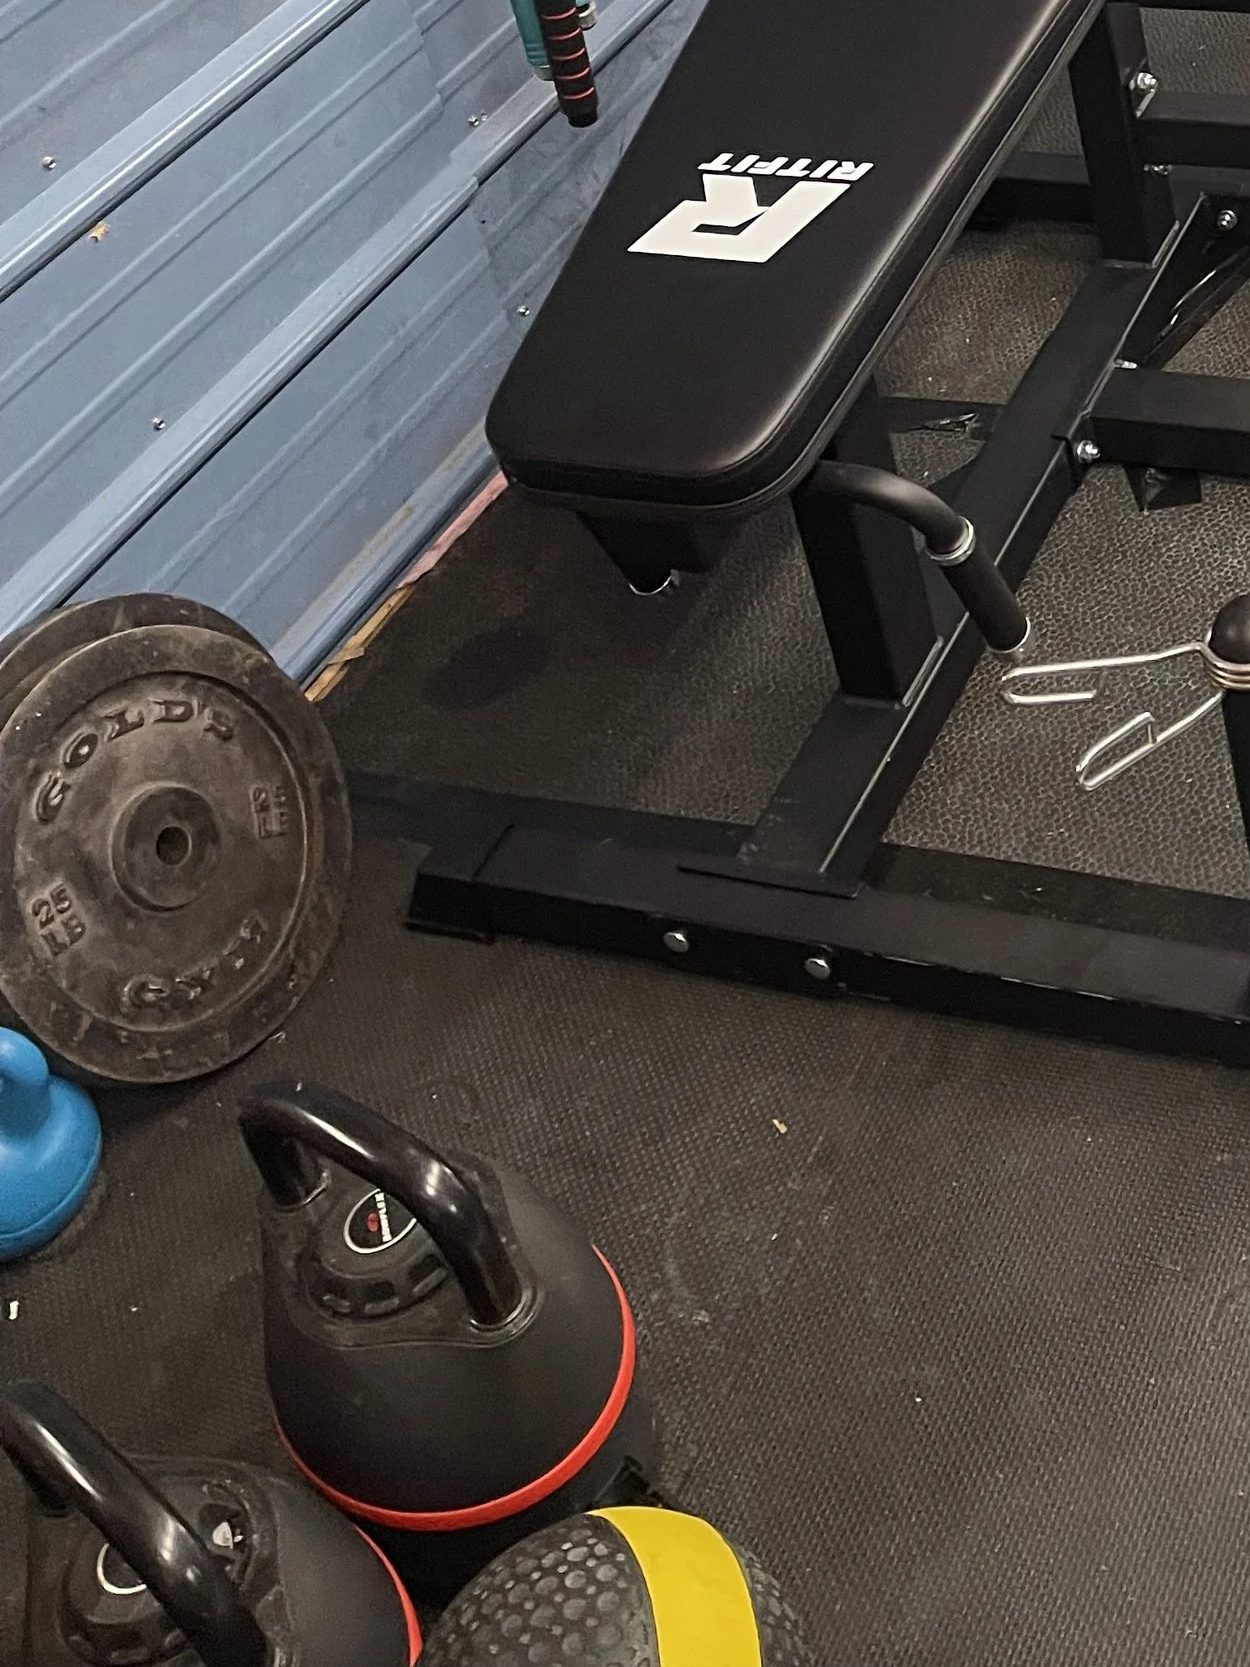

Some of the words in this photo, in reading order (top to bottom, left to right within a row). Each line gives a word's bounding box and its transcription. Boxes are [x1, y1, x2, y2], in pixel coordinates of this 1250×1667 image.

[698, 153, 875, 182] RITFIT
[34, 698, 235, 825] GOLD'S
[31, 884, 73, 929] 25
[40, 914, 86, 956] LB
